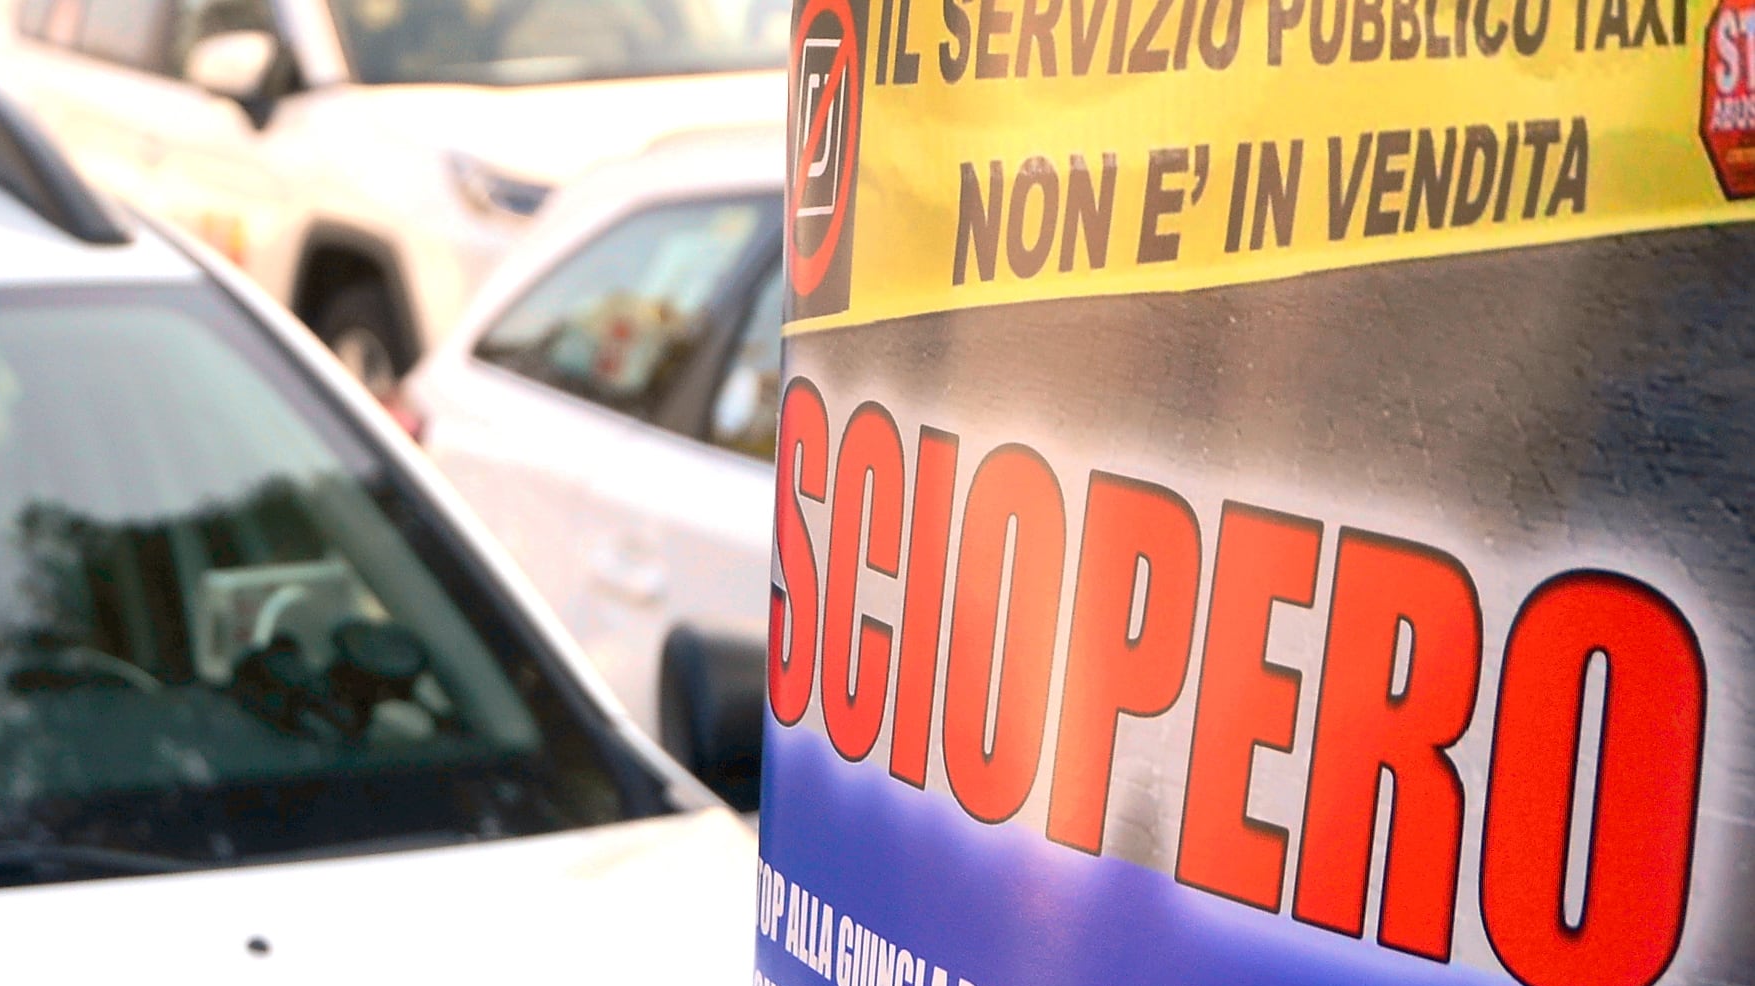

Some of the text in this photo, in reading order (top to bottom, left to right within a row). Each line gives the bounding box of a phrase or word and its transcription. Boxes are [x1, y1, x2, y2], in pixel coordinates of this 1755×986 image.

[875, 0, 920, 85] IL
[939, 0, 1245, 84] SERVIZIO
[1267, 0, 1547, 66] PUBBLICO
[952, 153, 1117, 286] NON
[1224, 139, 1303, 253] IN
[1328, 117, 1589, 241] VENDITA
[785, 881, 833, 981] ALLA
